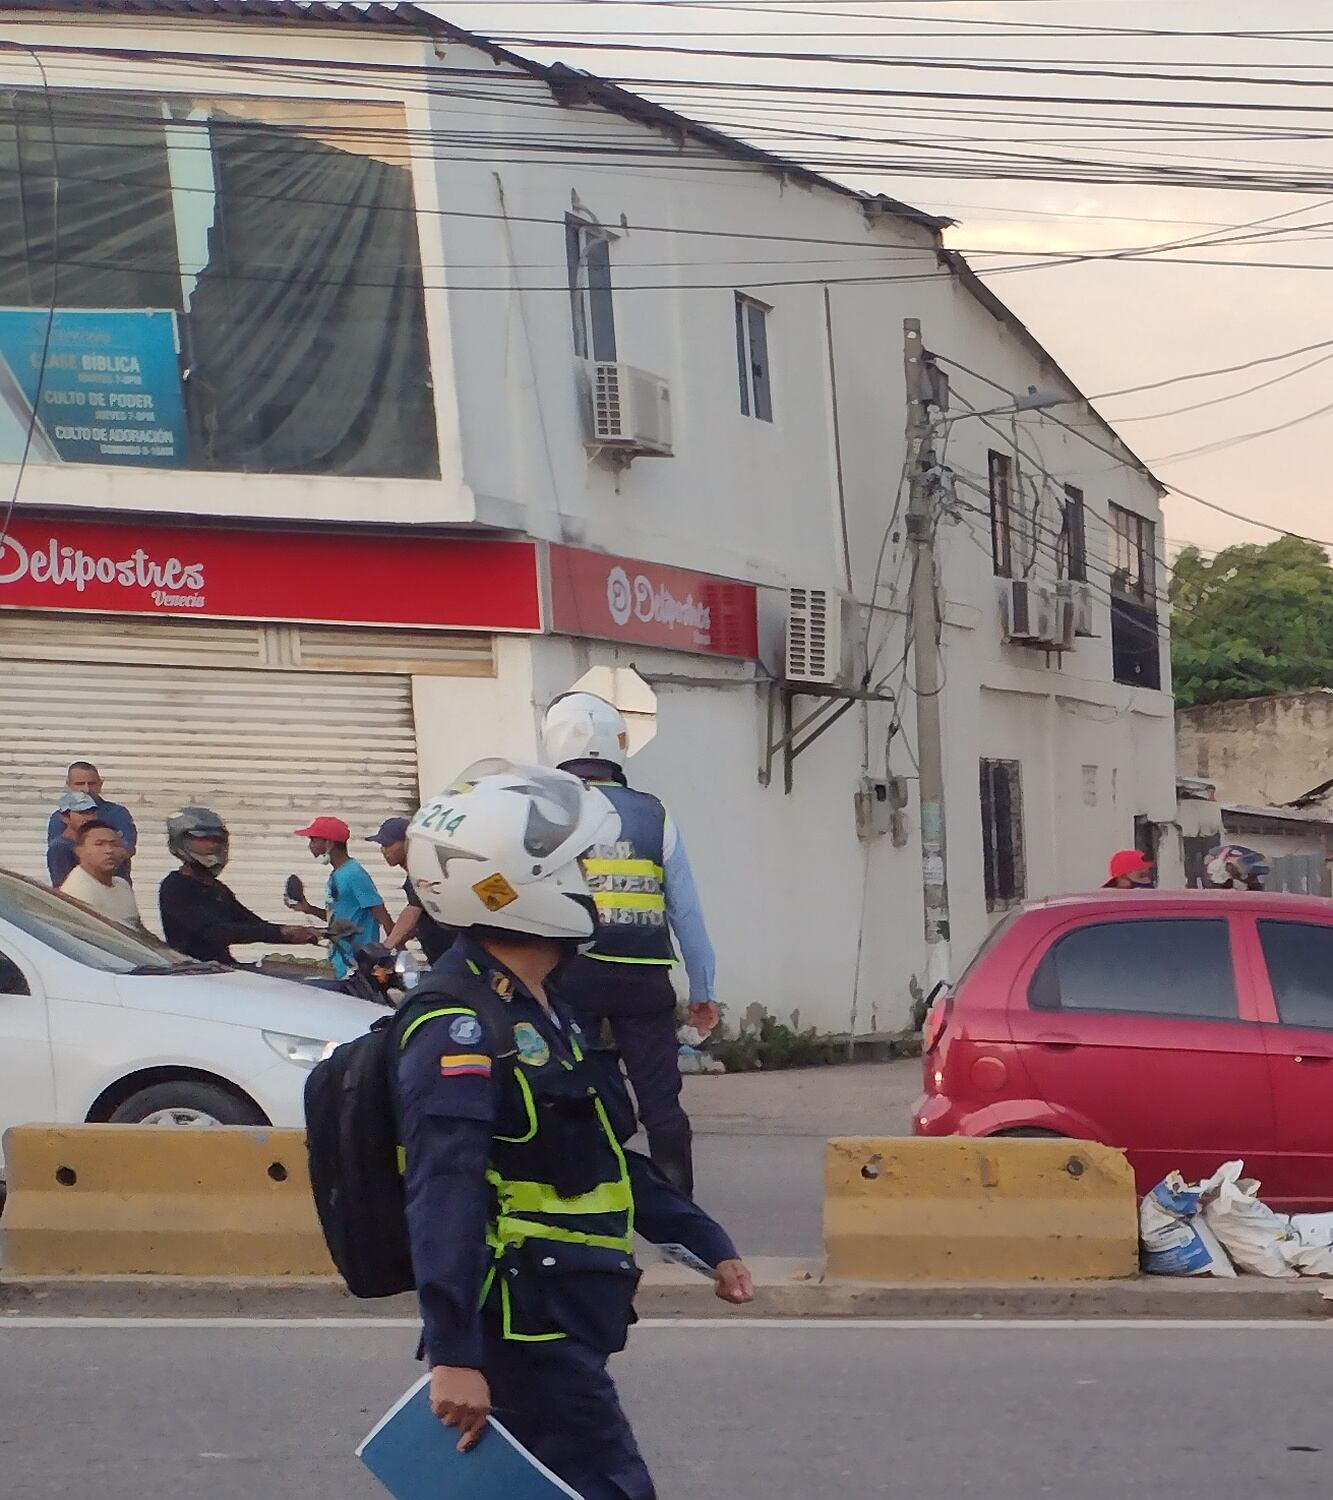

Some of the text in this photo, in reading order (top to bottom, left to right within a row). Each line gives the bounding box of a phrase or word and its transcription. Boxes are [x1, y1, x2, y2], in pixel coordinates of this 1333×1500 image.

[81, 352, 140, 373] BÍBLICA
[45, 391, 153, 408] CULTO DE PODER
[55, 426, 90, 440] CULTO
[93, 428, 107, 441] DE
